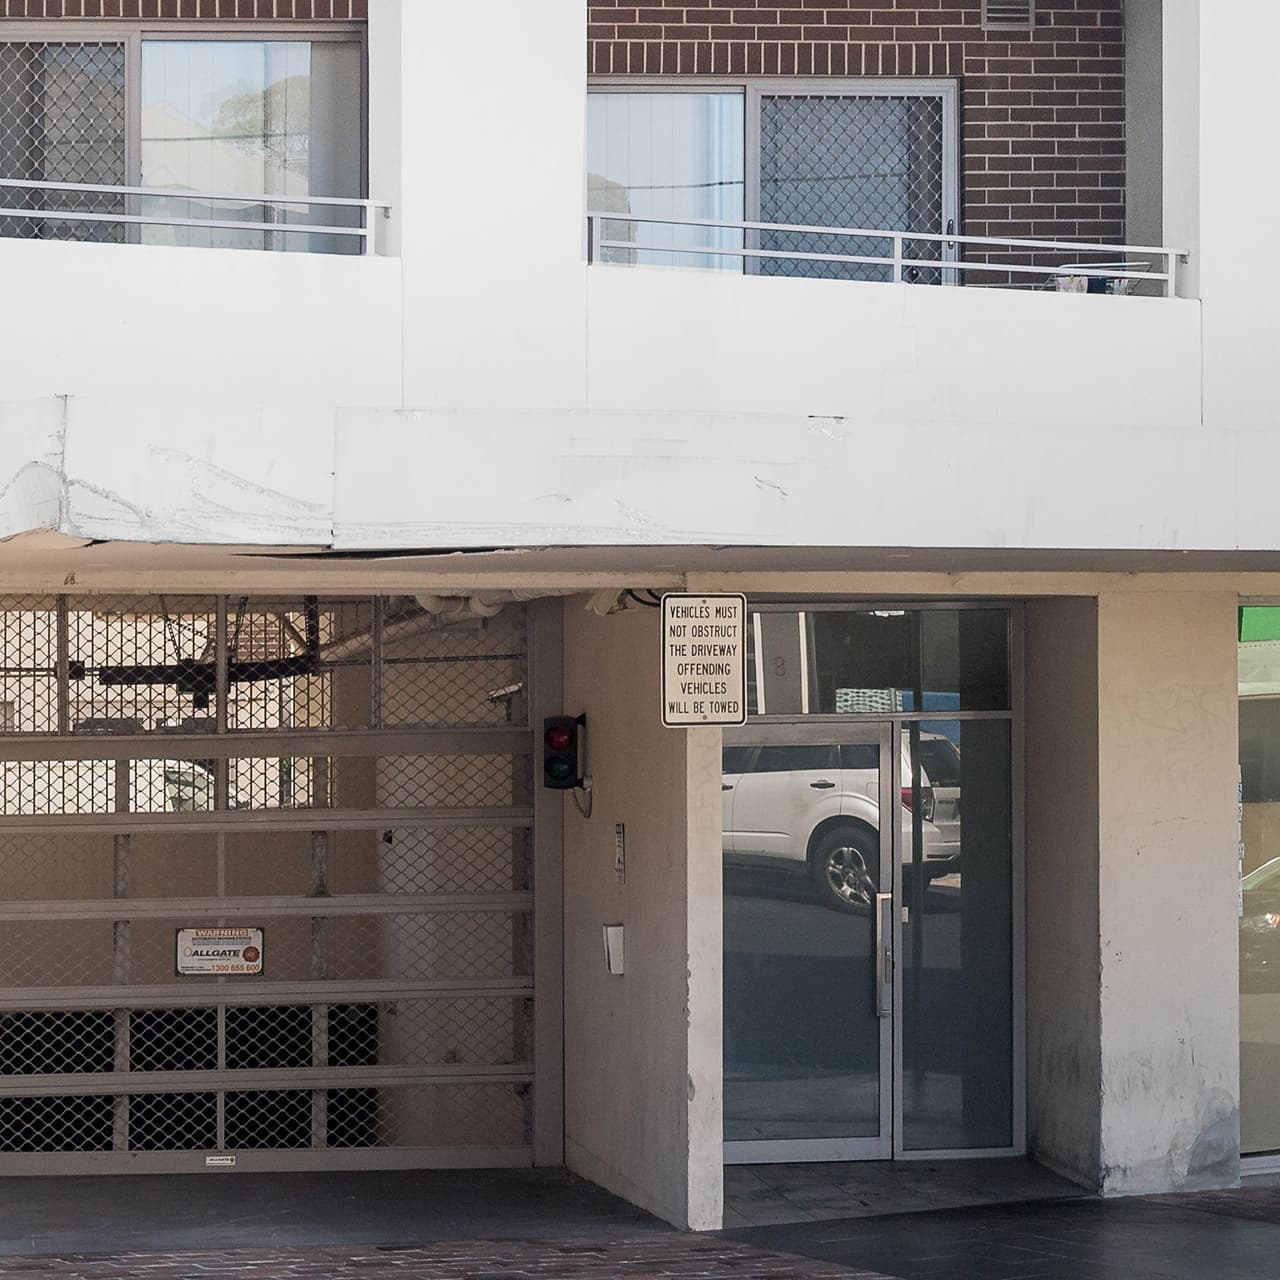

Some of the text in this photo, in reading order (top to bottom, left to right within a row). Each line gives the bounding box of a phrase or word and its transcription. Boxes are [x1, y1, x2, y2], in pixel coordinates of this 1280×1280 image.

[670, 606, 737, 619] VEHICLES MUST
[669, 625, 737, 638] NOT OBSTRUCT
[669, 644, 738, 657] THE DRIVEWAY
[677, 663, 731, 676] OFFENDING
[680, 682, 727, 695] VEHICLES
[668, 701, 739, 714] WILL BE TOWED
[192, 949, 240, 957] ALLGATE
